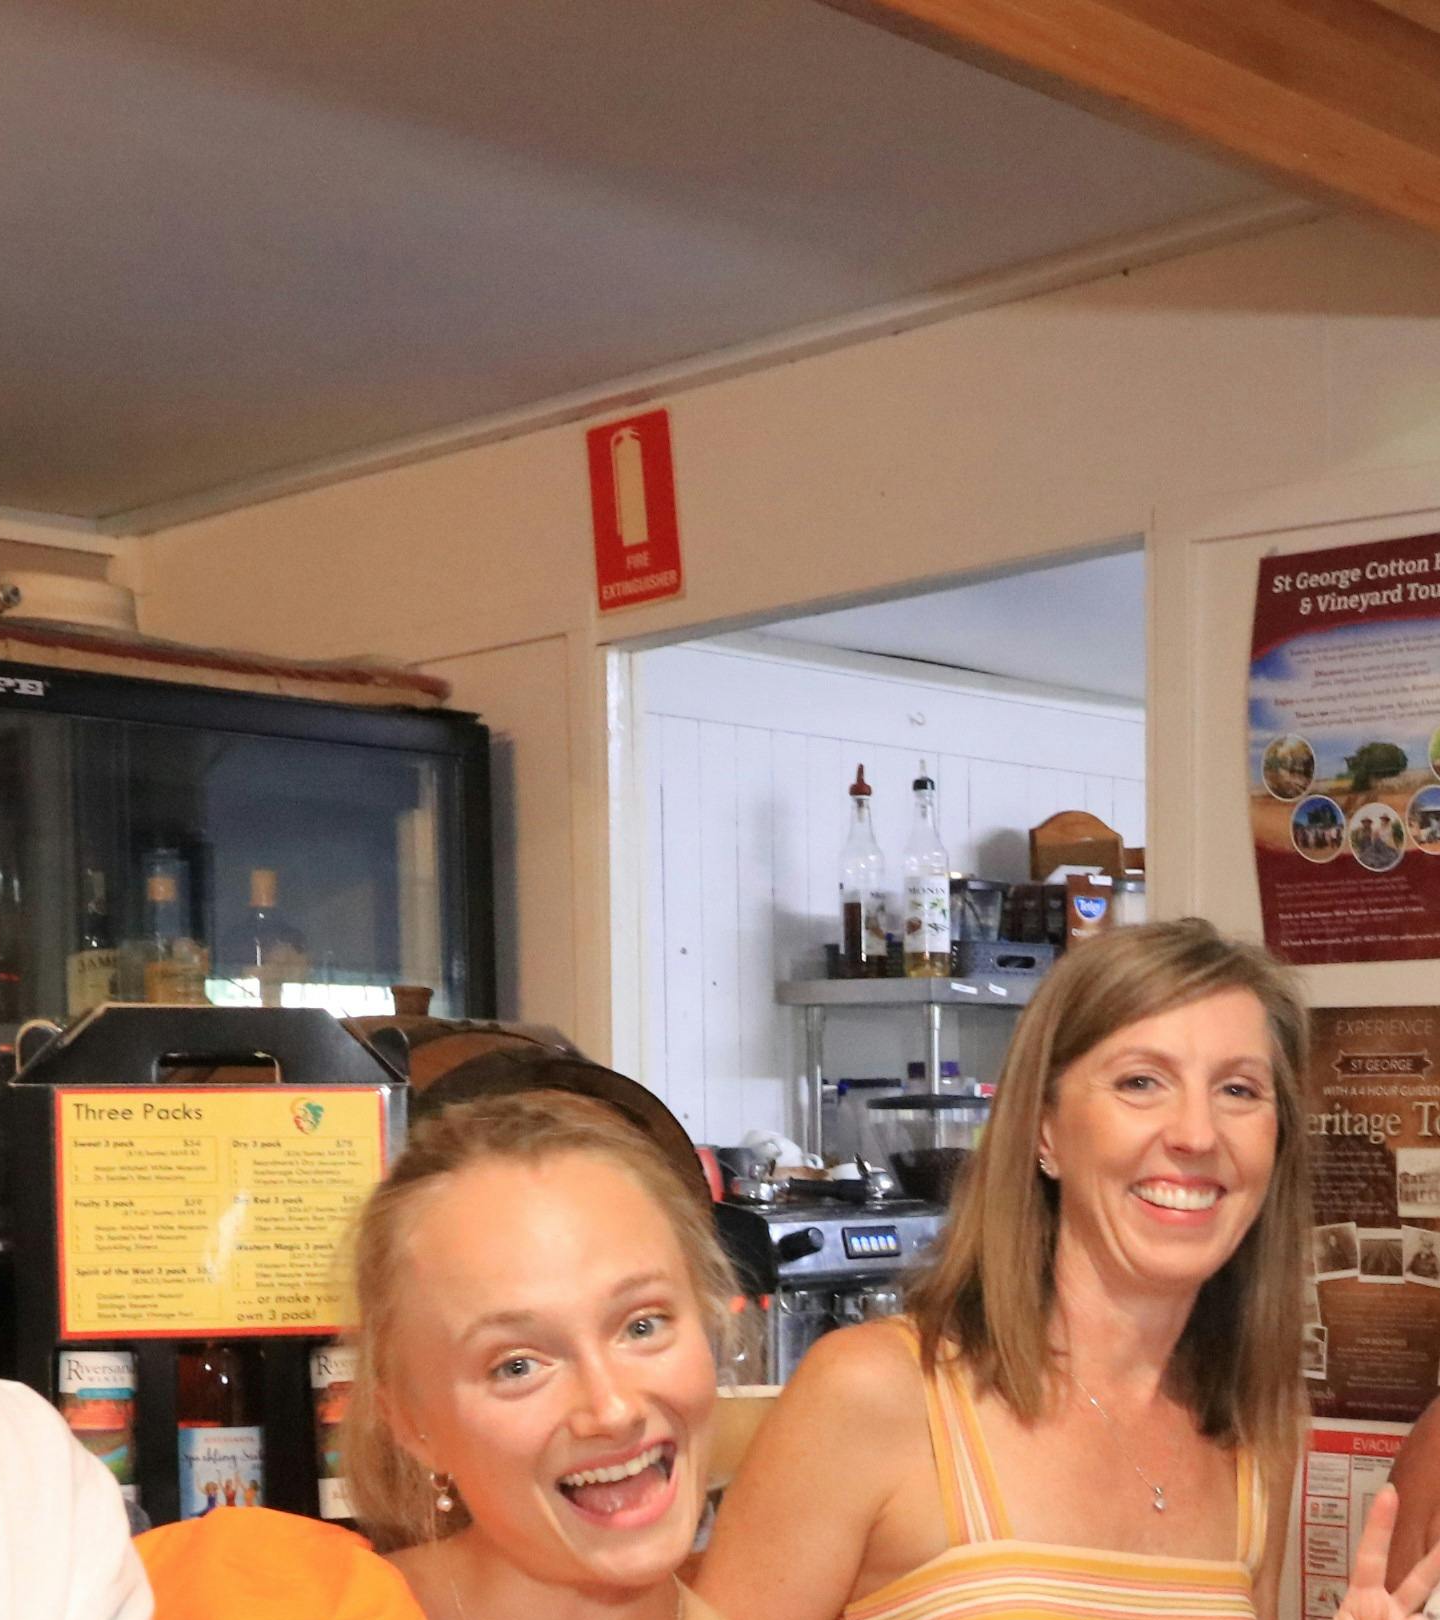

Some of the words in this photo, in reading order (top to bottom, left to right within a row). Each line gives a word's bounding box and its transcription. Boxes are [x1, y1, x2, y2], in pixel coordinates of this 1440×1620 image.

[626, 551, 649, 571] FIRE
[602, 569, 678, 600] EXTINGUISHER
[1272, 575, 1293, 593] St
[1295, 567, 1361, 590] George
[1365, 557, 1430, 580] Cotton
[1299, 597, 1312, 615] &
[1316, 584, 1403, 613] Vineyard
[1336, 1018, 1434, 1036] EXPERIENCE
[1366, 1058, 1413, 1072] GEORGE
[1323, 1086, 1347, 1096] WITH
[1367, 1086, 1398, 1096] HOUR
[1400, 1085, 1440, 1096] GUIDED
[73, 1102, 134, 1121] Three
[143, 1102, 203, 1121] Packs
[1306, 1102, 1402, 1145] eritage
[1353, 1436, 1401, 1453] EVACUA
